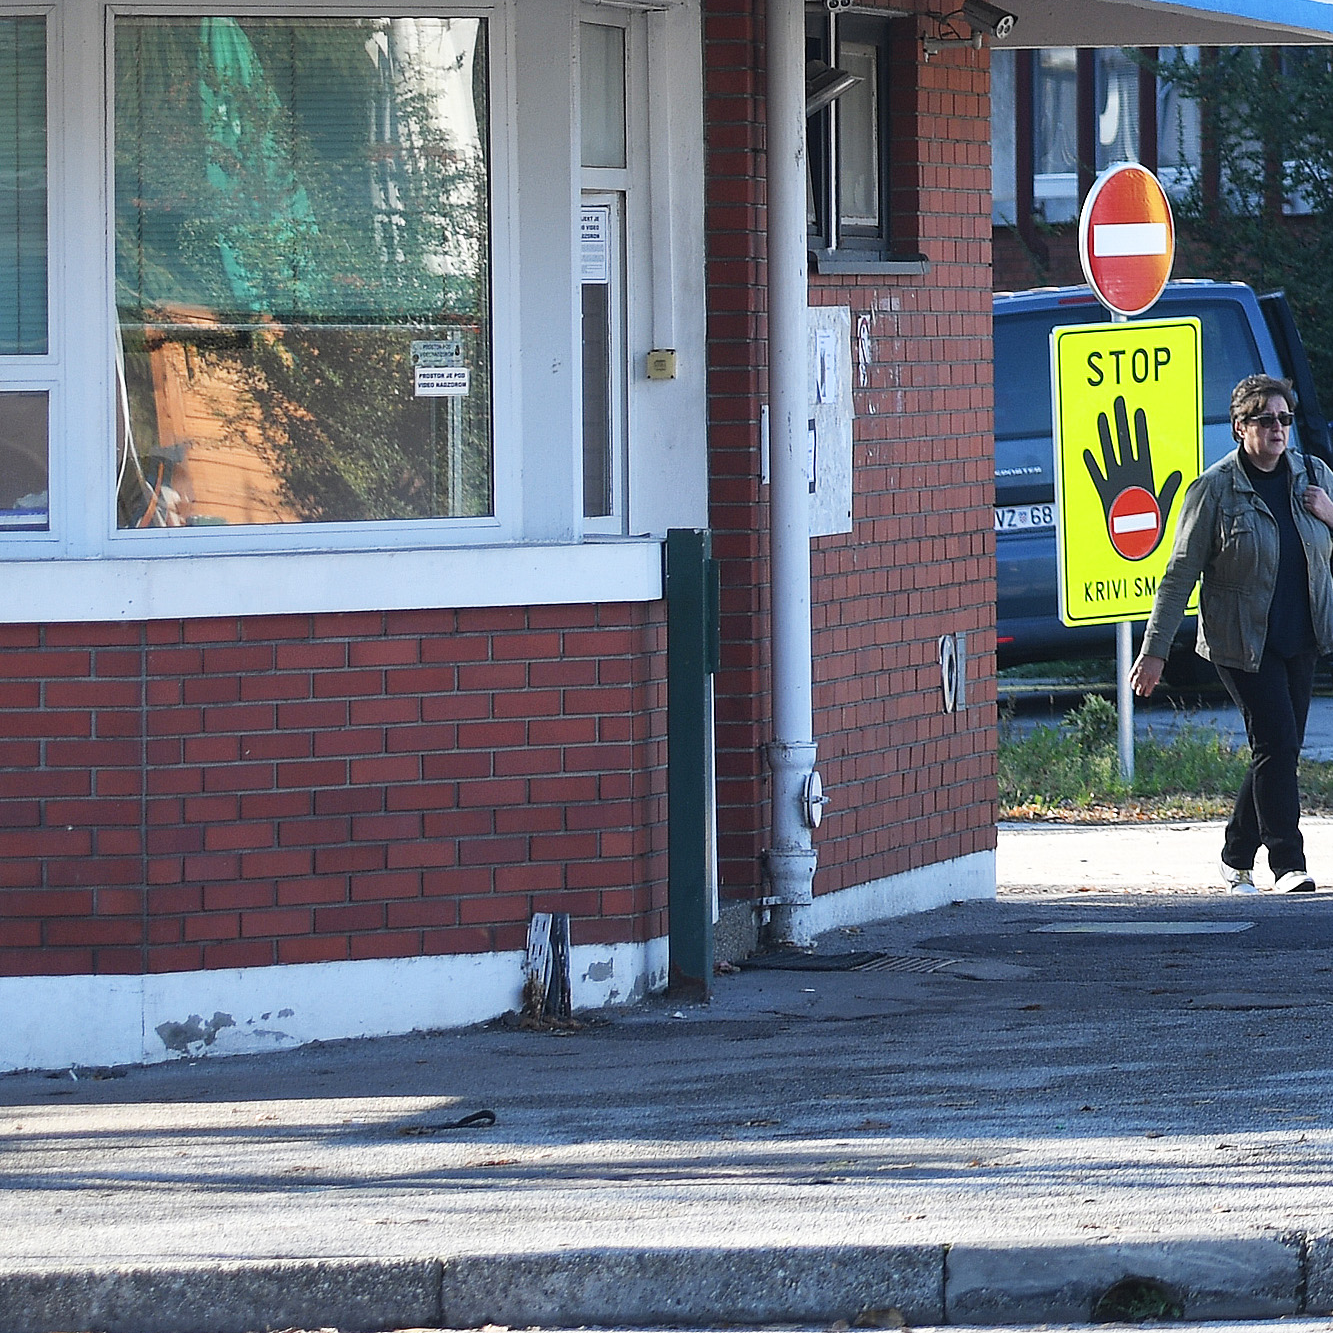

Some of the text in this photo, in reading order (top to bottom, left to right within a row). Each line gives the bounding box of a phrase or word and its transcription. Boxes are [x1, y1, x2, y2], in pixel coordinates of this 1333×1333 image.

[1087, 347, 1171, 386] STOP
[995, 509, 1016, 528] VZ
[1084, 575, 1157, 603] KRIVI SM
